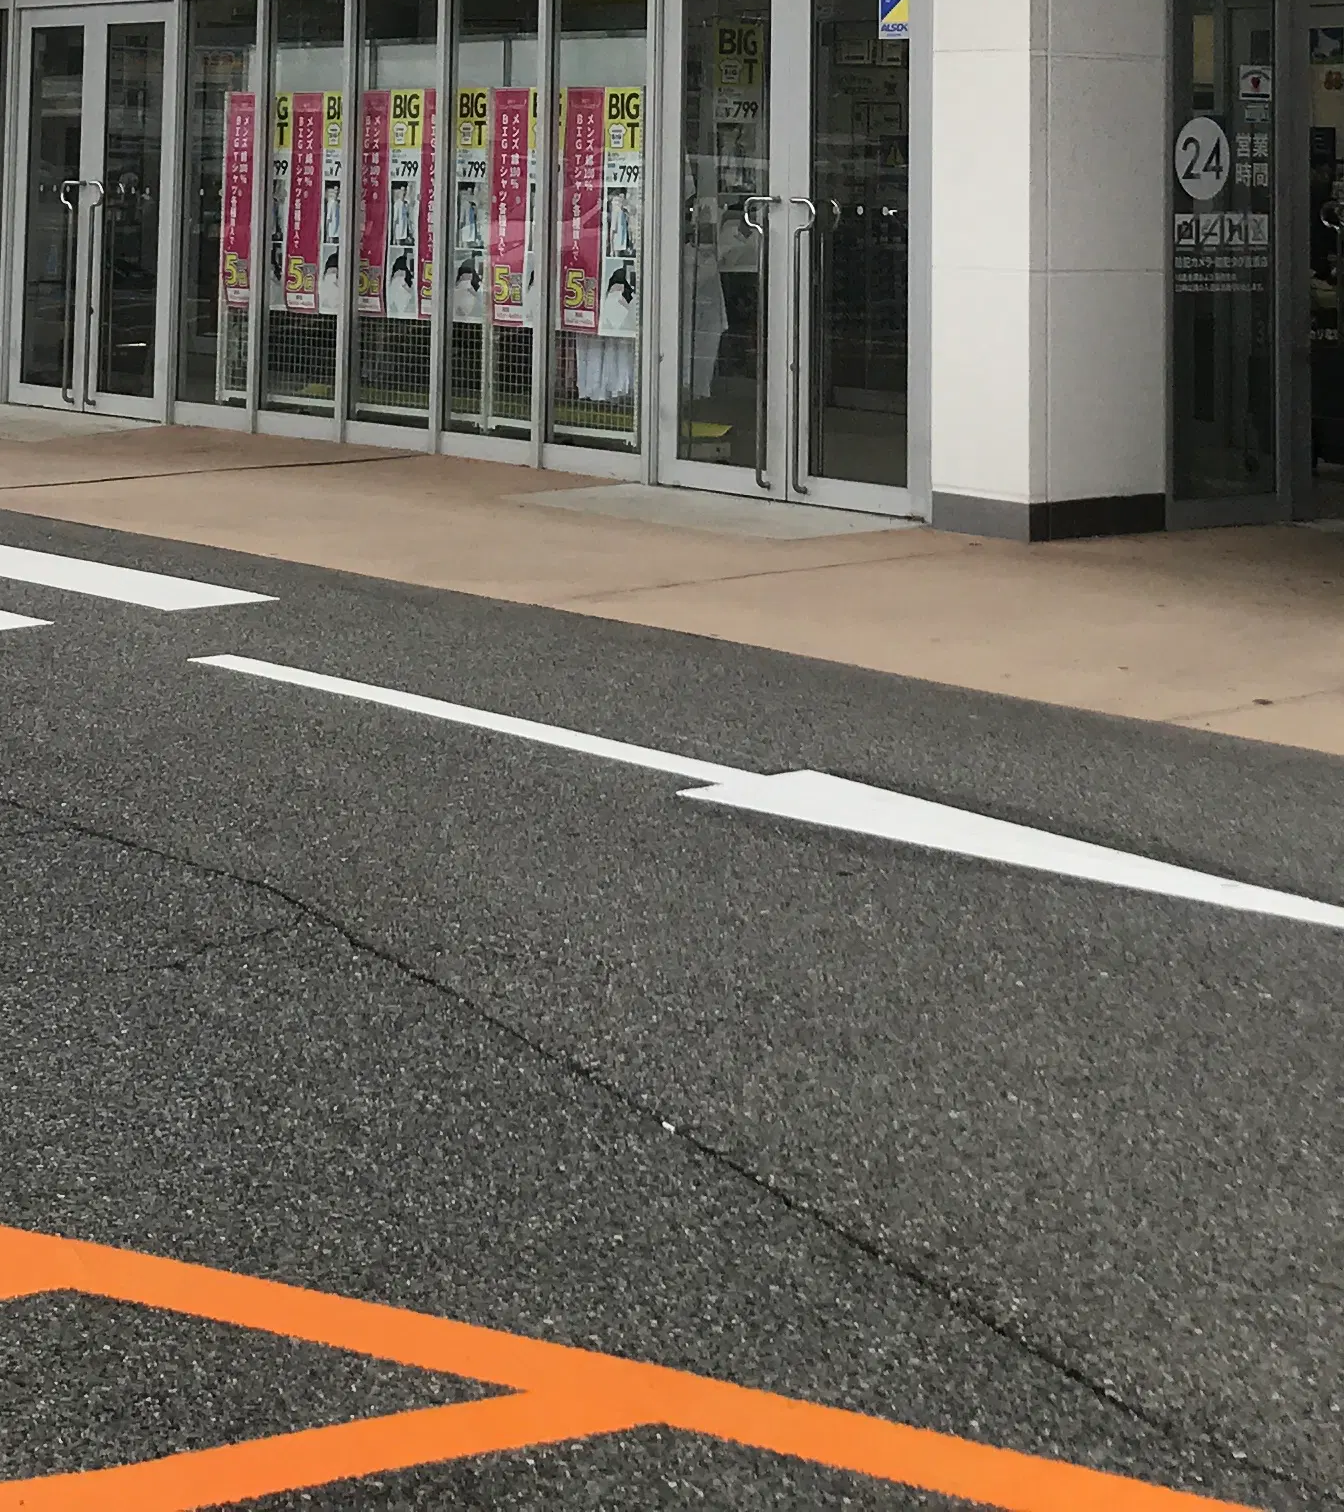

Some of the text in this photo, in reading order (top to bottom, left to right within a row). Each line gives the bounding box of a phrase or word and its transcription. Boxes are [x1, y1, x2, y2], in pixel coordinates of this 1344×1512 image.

[719, 28, 757, 56] BIG
[744, 58, 758, 84] T
[393, 94, 420, 119] BIG
[459, 93, 486, 118] BIG
[608, 93, 639, 120] BIG
[408, 121, 419, 146] T
[474, 121, 486, 146] T
[627, 123, 639, 148] T
[1236, 132, 1269, 158] 営業
[1182, 136, 1223, 180] 24
[1236, 162, 1268, 187] 時間
